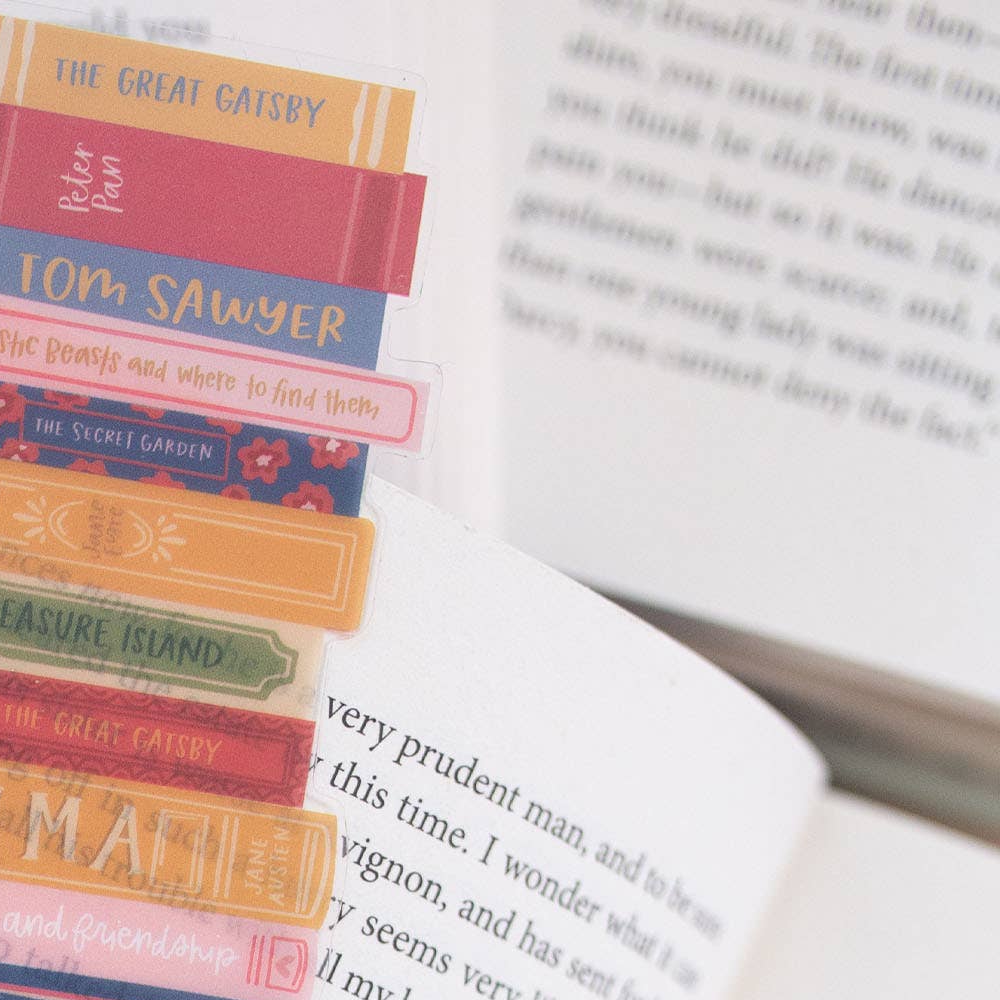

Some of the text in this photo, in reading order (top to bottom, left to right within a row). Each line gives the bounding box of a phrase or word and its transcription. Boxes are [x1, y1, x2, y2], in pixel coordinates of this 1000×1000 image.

[55, 57, 327, 129] THE GREAT GATSBY
[57, 141, 96, 214] Peter
[90, 154, 125, 214] Pan
[146, 273, 346, 347] SAWYER
[46, 336, 121, 376] Beasts
[127, 353, 168, 383] and
[177, 364, 236, 393] where
[246, 375, 267, 400] to
[272, 378, 318, 411] find
[324, 394, 381, 419] them
[34, 416, 213, 461] THE SECRET GARDEN
[121, 626, 225, 670] ISLAND
[3, 702, 224, 765] THE GREAT GATSBY
[328, 696, 397, 751] very
[394, 736, 521, 813] prudent
[522, 800, 589, 858] man,
[245, 836, 268, 895] JANE
[268, 825, 290, 906] AUSTEN
[330, 760, 601, 922] this time. I wonder
[3, 906, 70, 940] and
[361, 914, 452, 975] seems
[457, 899, 518, 942] and
[519, 920, 563, 968] has
